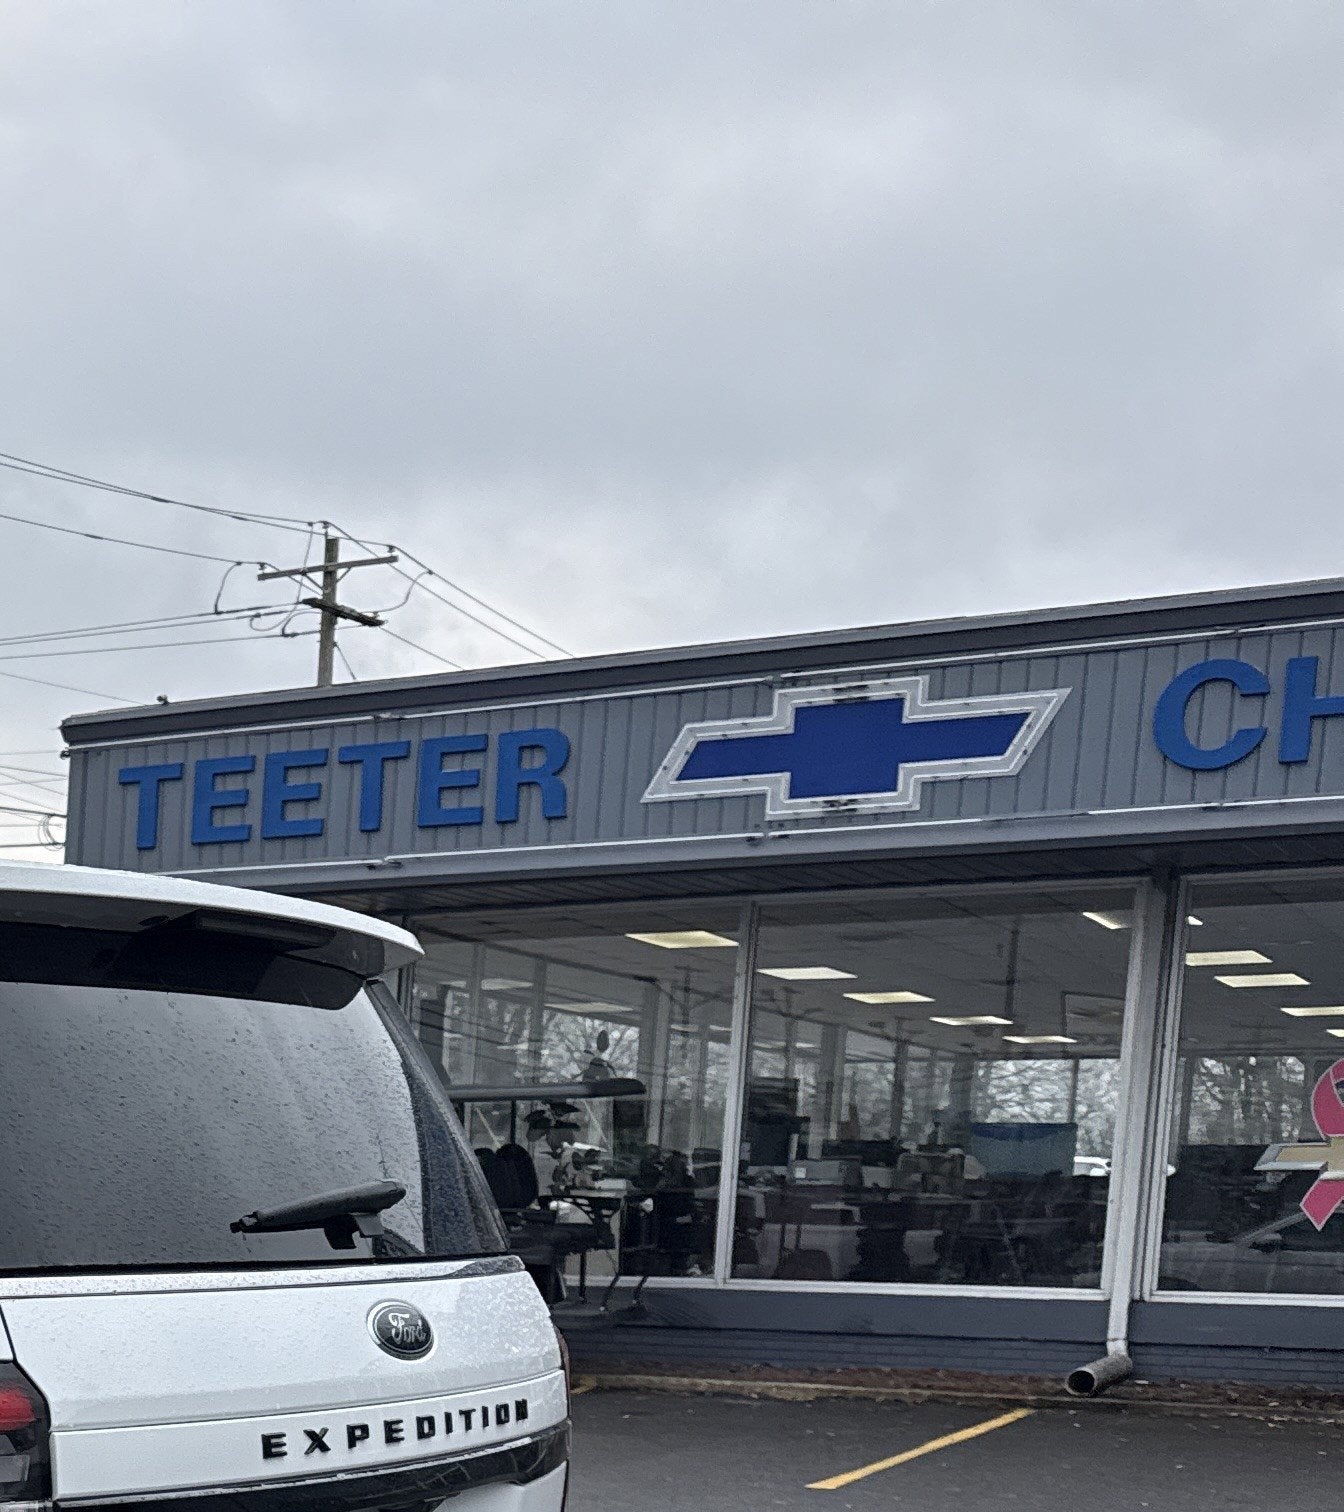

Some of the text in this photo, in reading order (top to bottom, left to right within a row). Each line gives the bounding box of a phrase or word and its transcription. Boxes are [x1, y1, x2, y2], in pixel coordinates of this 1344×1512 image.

[118, 727, 570, 851] TEETER
[388, 1312, 427, 1344] Ford
[261, 1398, 529, 1460] EXPEDITION
